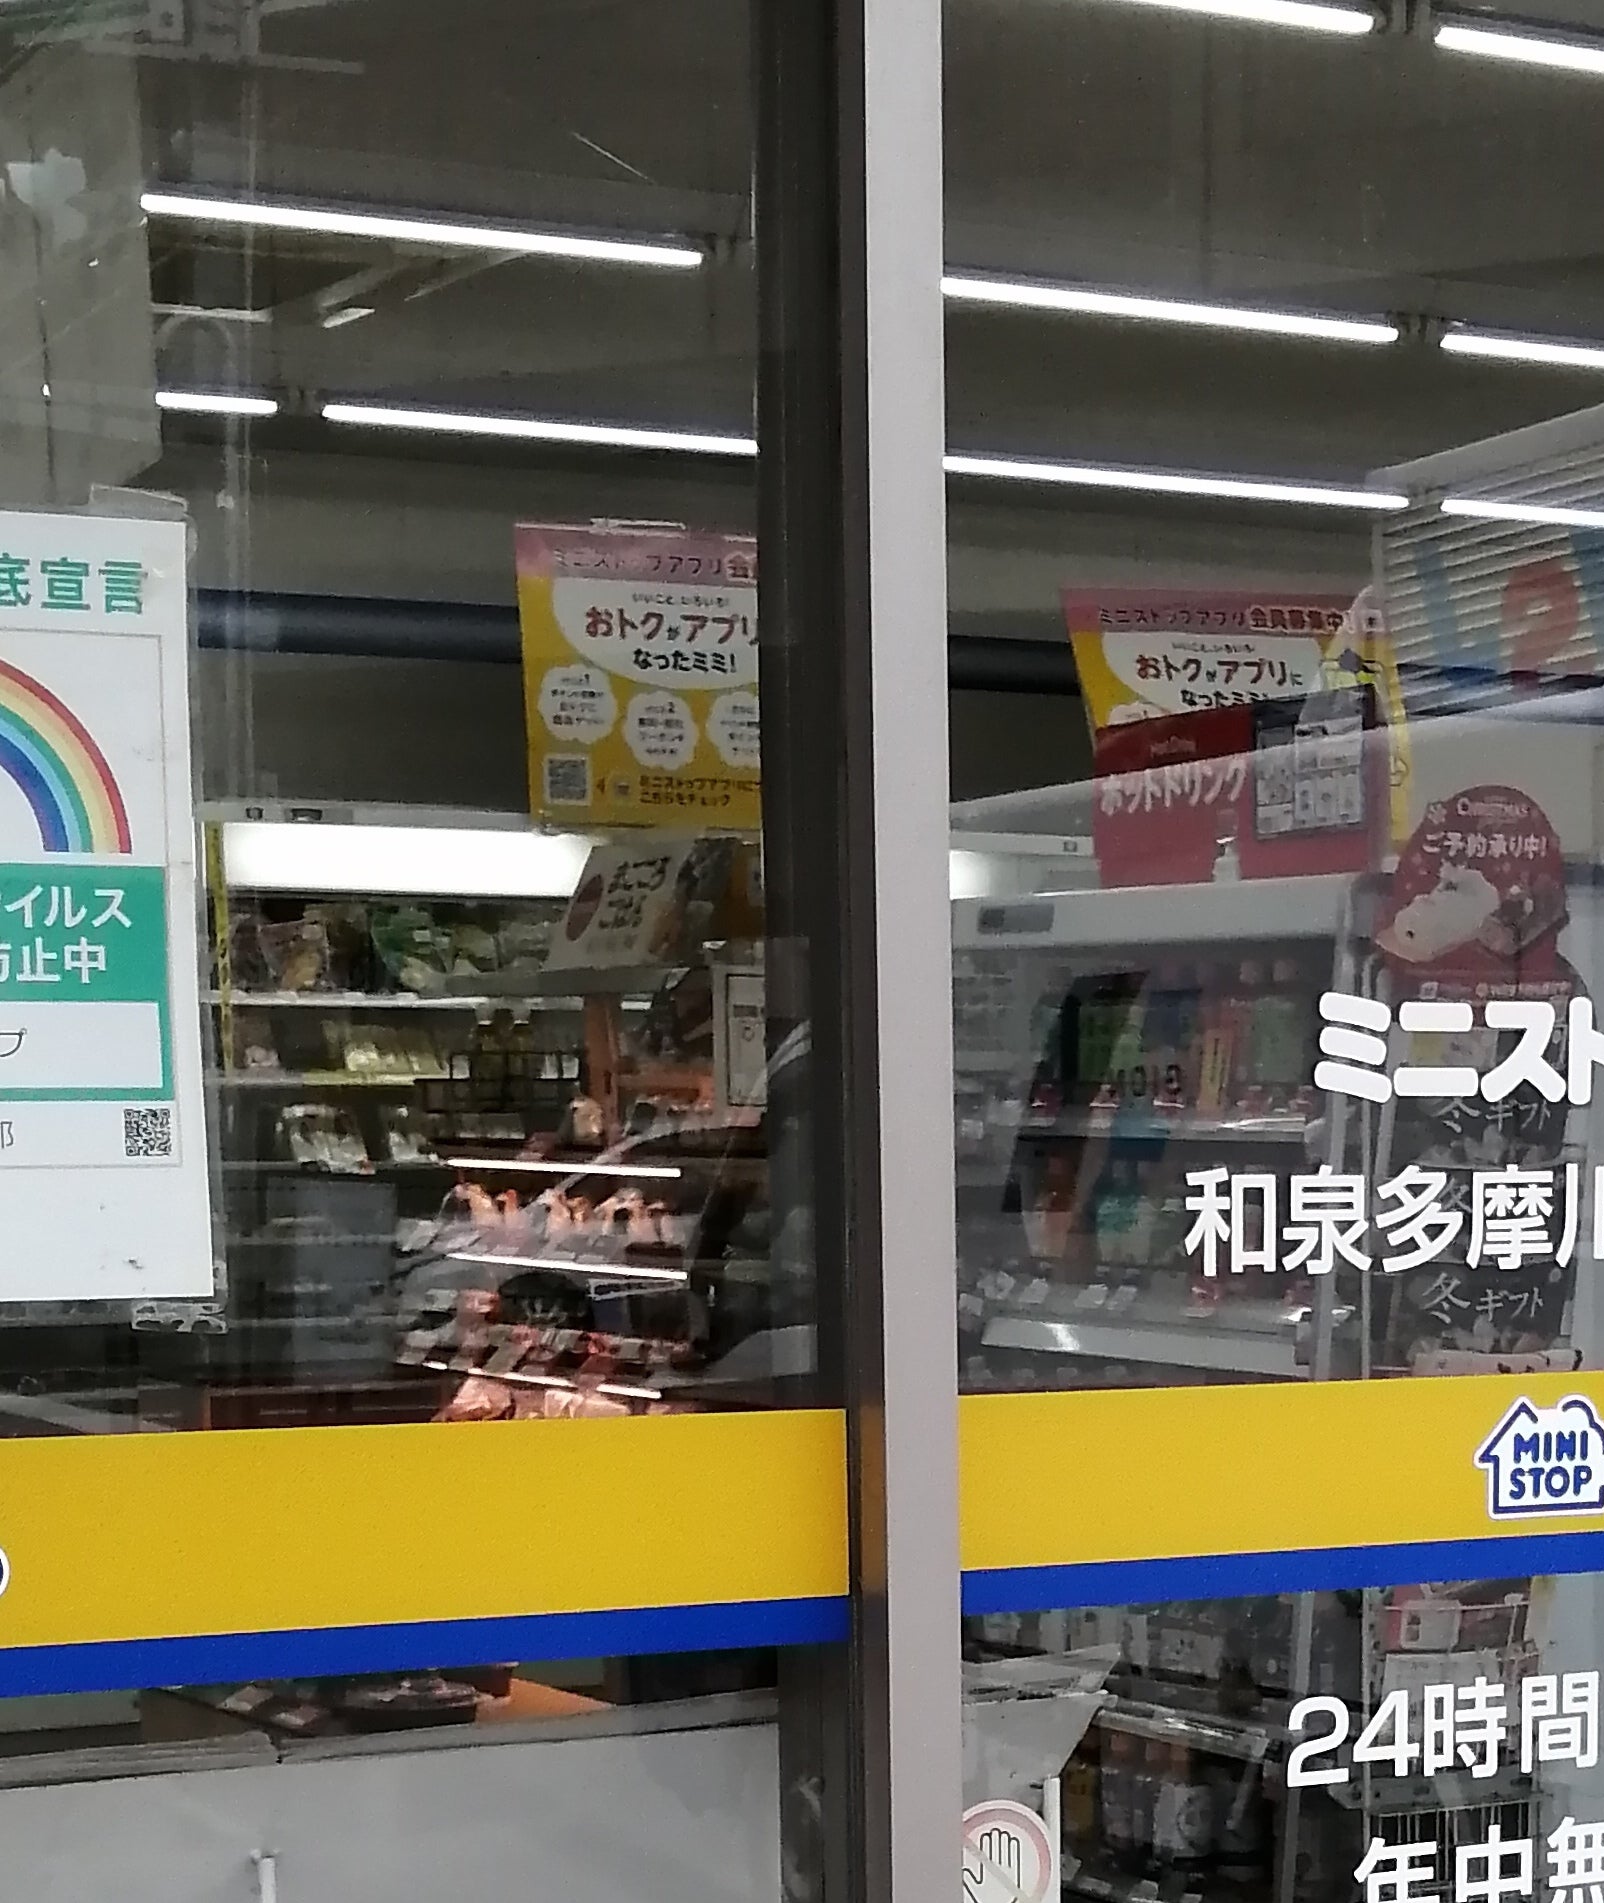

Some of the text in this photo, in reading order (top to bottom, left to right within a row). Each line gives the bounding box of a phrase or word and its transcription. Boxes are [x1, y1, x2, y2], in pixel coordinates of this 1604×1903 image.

[633, 649, 736, 674] なったミミ!
[0, 884, 132, 929] イルス
[1422, 1272, 1544, 1325] 冬ギフト
[1512, 1429, 1590, 1467] MINI
[1508, 1461, 1596, 1502] STOP
